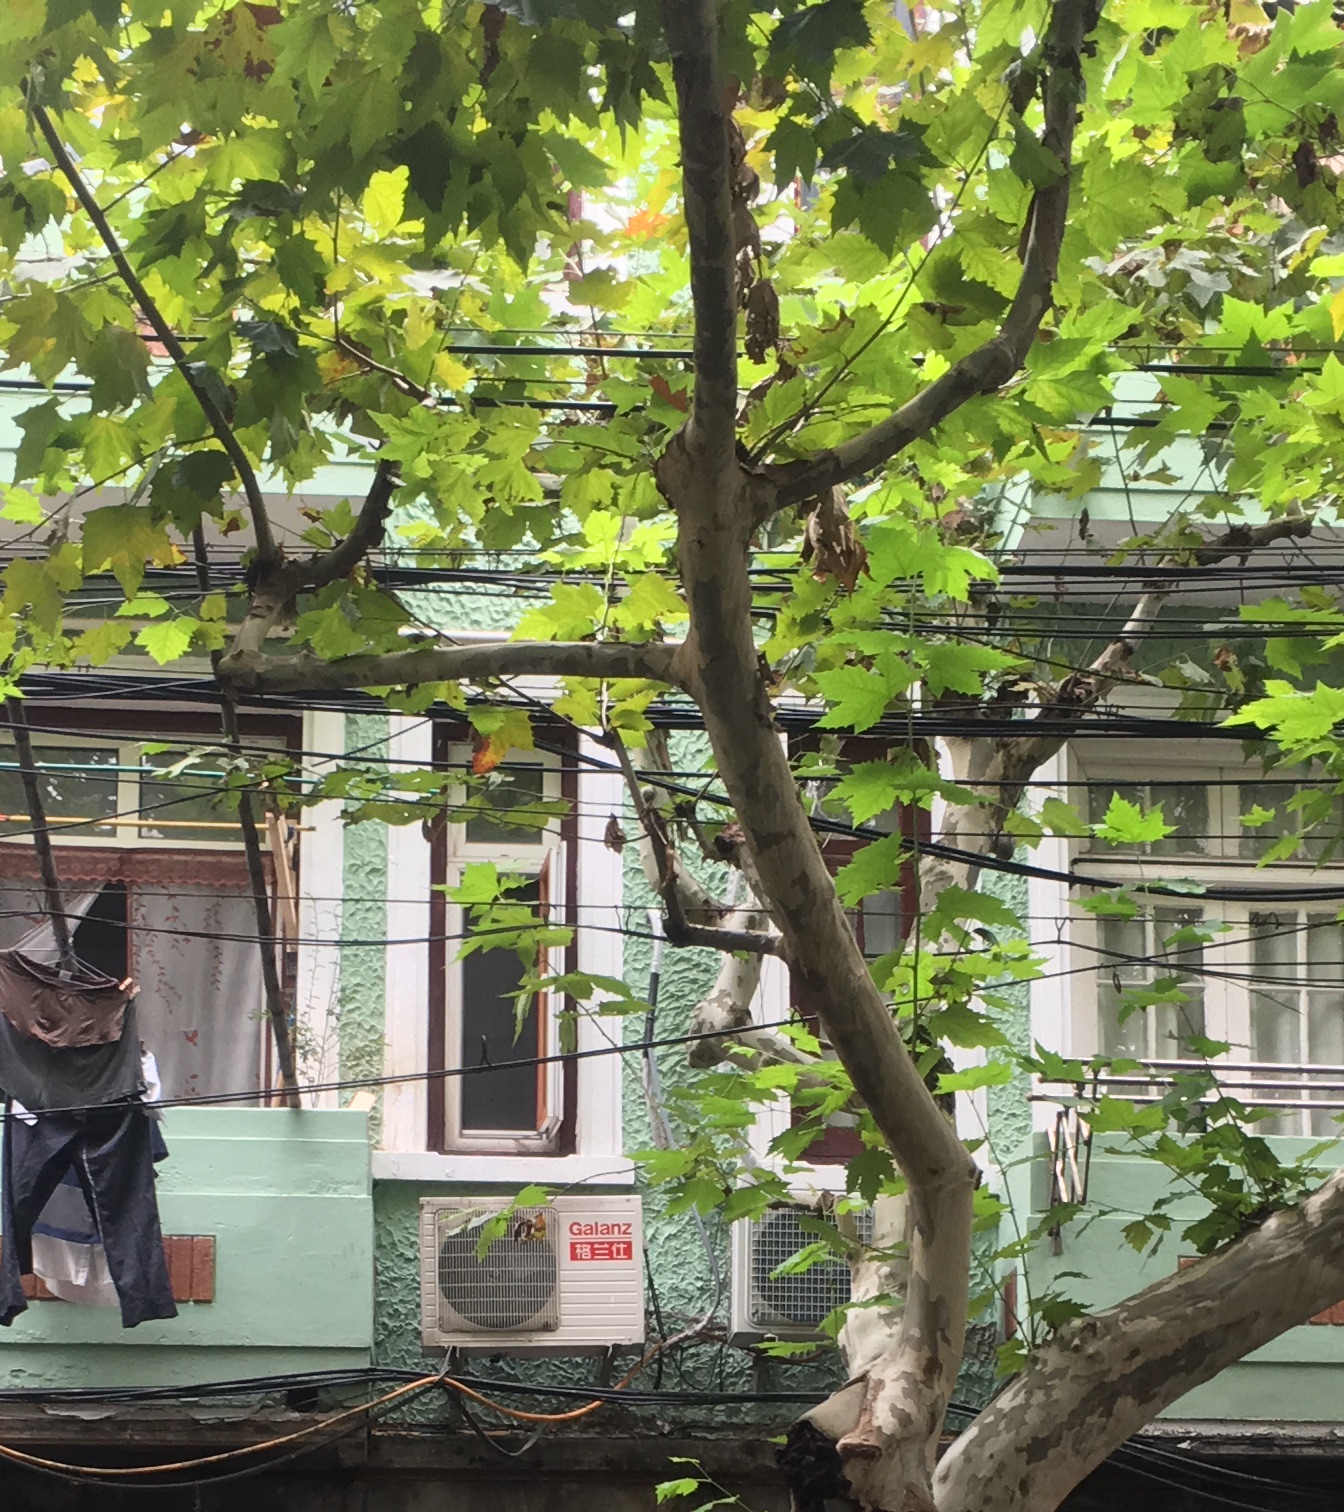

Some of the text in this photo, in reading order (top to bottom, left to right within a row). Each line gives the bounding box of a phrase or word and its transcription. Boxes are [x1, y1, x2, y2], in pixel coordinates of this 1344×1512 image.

[568, 1221, 632, 1236] Galanz
[574, 1242, 629, 1260] 格兰仕
